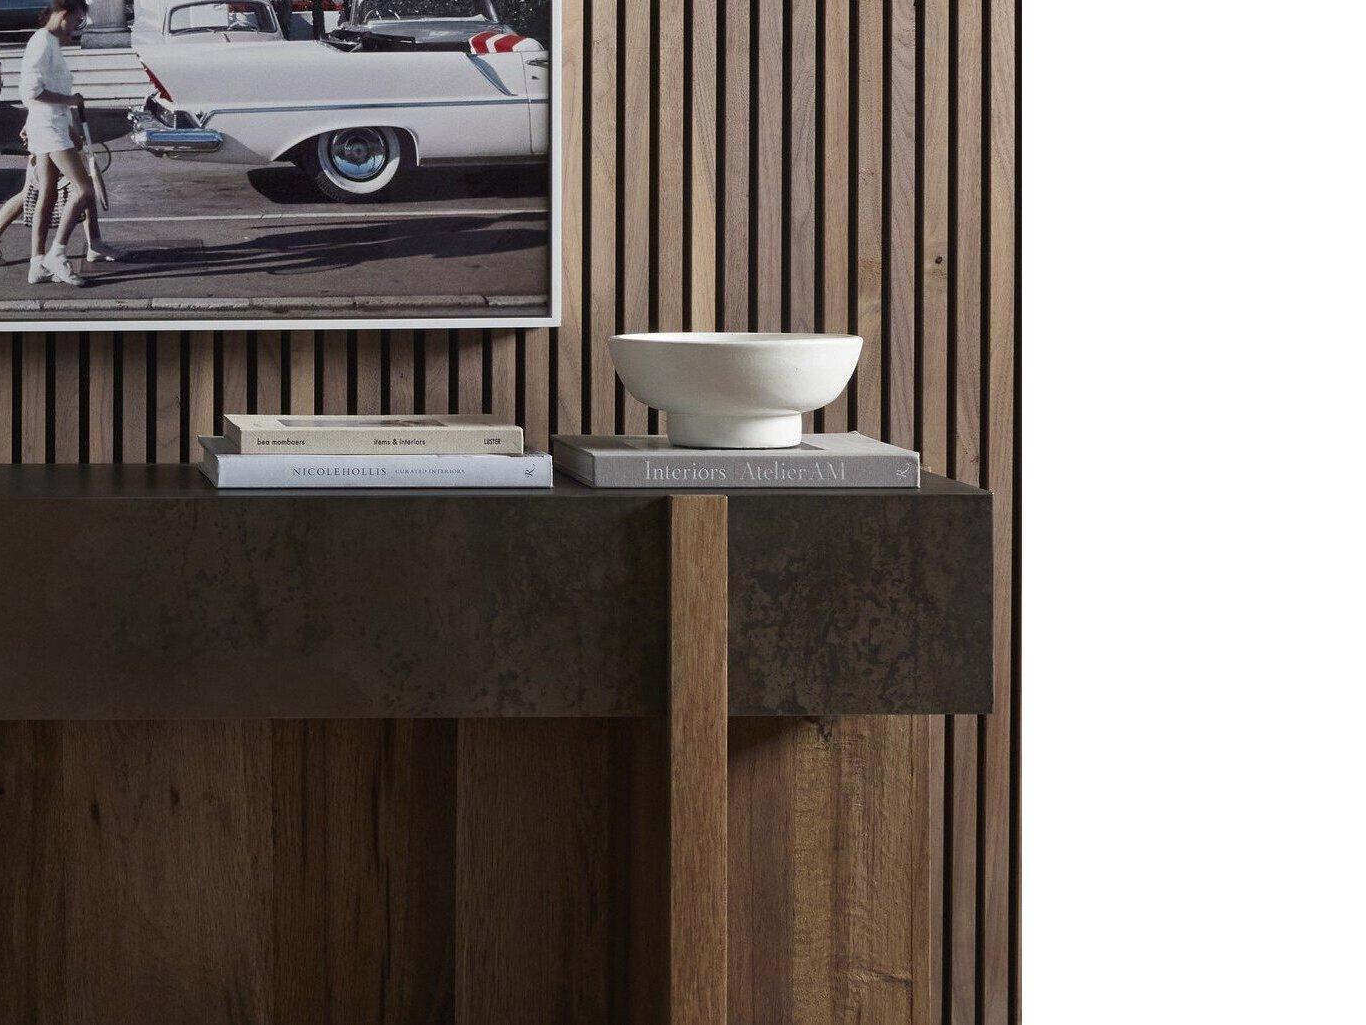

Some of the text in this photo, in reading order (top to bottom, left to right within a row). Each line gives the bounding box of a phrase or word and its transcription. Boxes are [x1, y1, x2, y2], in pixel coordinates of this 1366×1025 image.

[256, 438, 270, 446] bea
[373, 438, 426, 446] items & interiors
[645, 460, 727, 481] Interiors
[739, 460, 846, 480] Atelier AM
